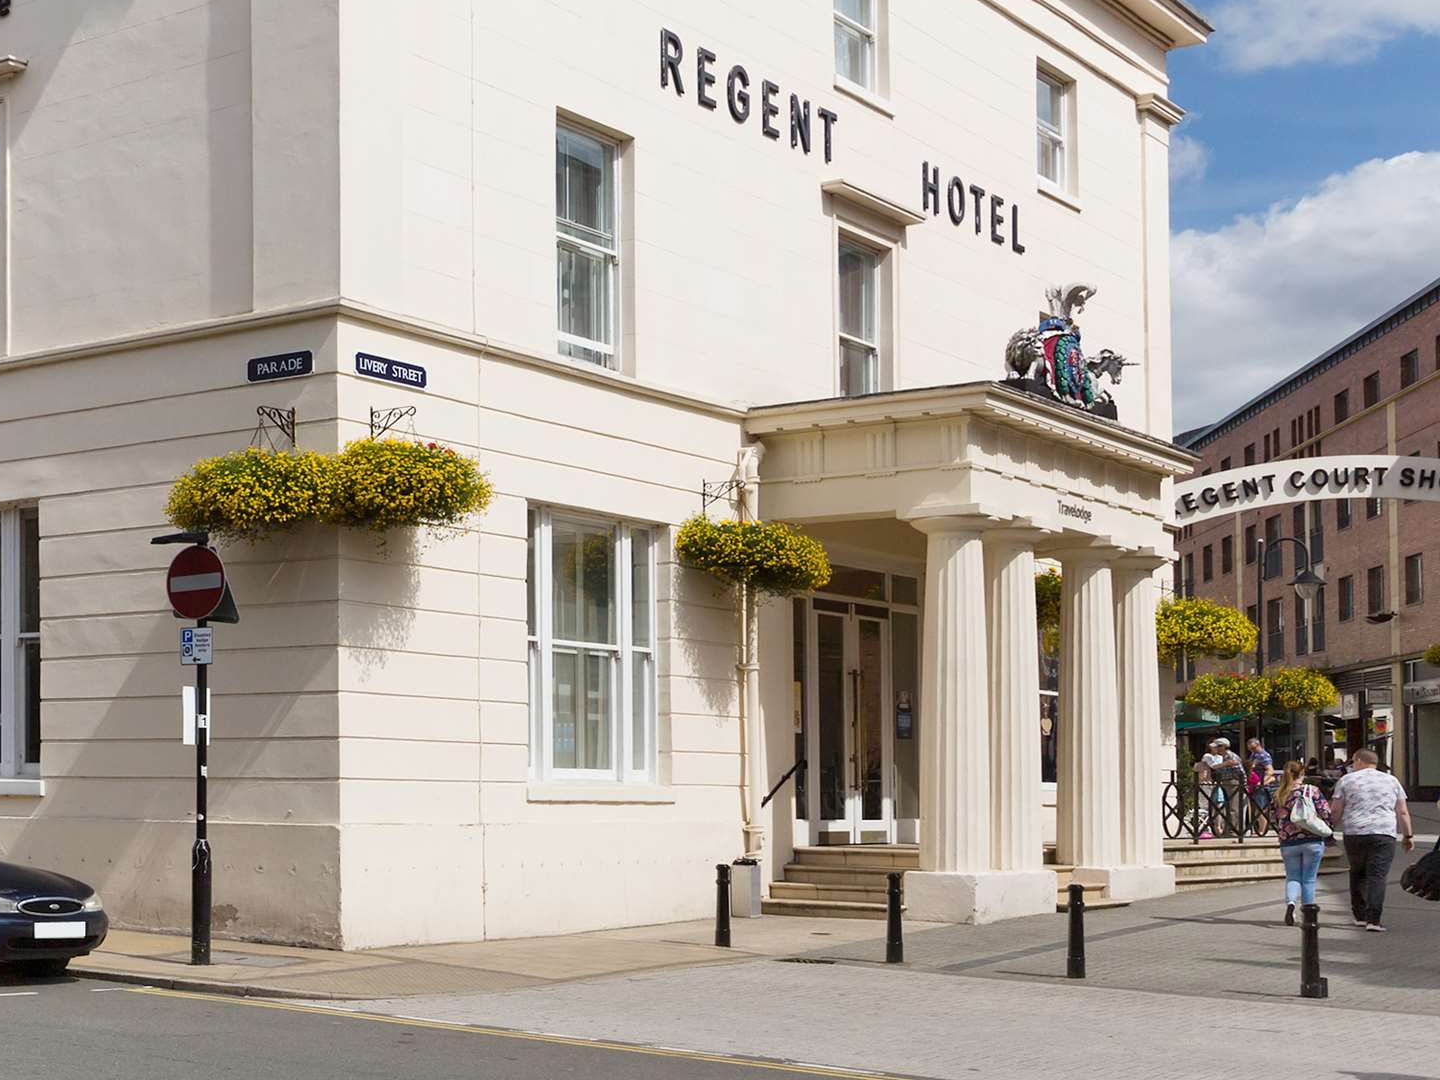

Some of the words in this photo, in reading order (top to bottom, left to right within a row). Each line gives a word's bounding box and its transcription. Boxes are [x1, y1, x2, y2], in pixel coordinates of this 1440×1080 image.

[660, 28, 837, 164] REGENT
[923, 161, 1025, 255] HOTEL
[257, 357, 303, 375] PARADE
[359, 358, 388, 375] LIVERY
[392, 366, 423, 383] STREET
[1174, 474, 1276, 519] EGENT
[1290, 467, 1388, 489] COURT
[1400, 467, 1440, 489] SH
[1057, 499, 1092, 524] Travelodge
